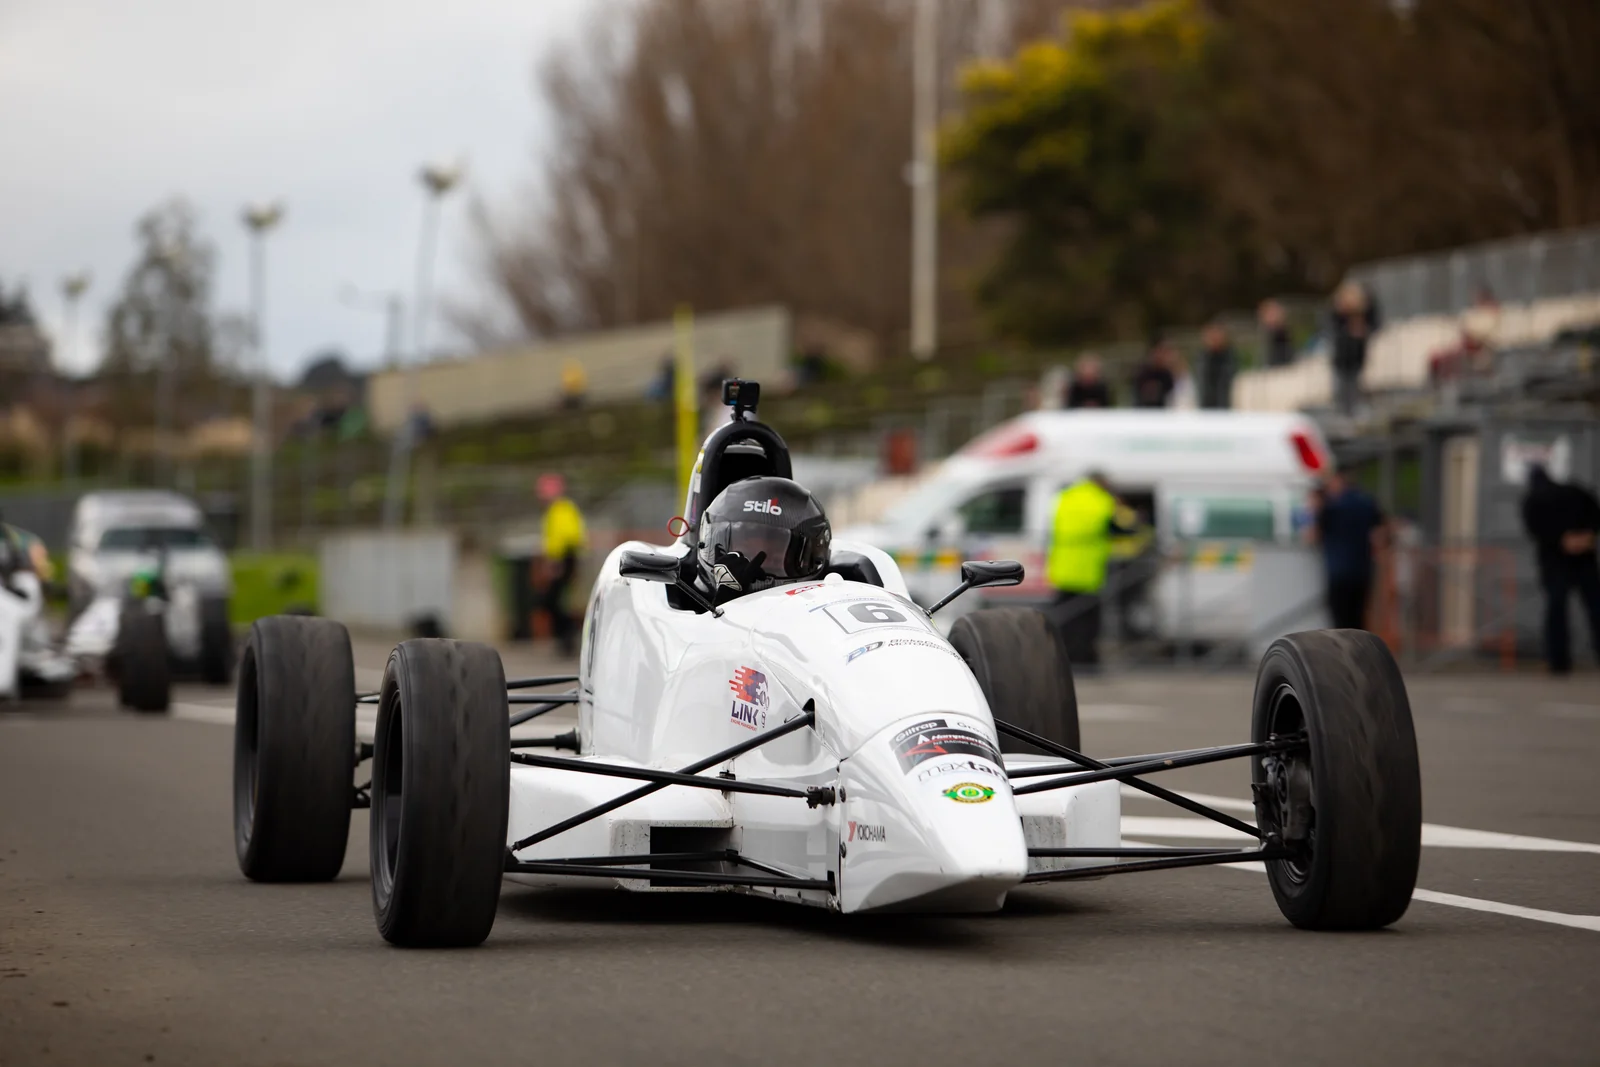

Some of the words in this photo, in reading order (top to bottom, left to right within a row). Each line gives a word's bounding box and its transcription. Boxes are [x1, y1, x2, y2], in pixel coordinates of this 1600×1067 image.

[847, 602, 908, 624] 6
[731, 700, 759, 726] LINK
[917, 760, 1009, 783] maxtar
